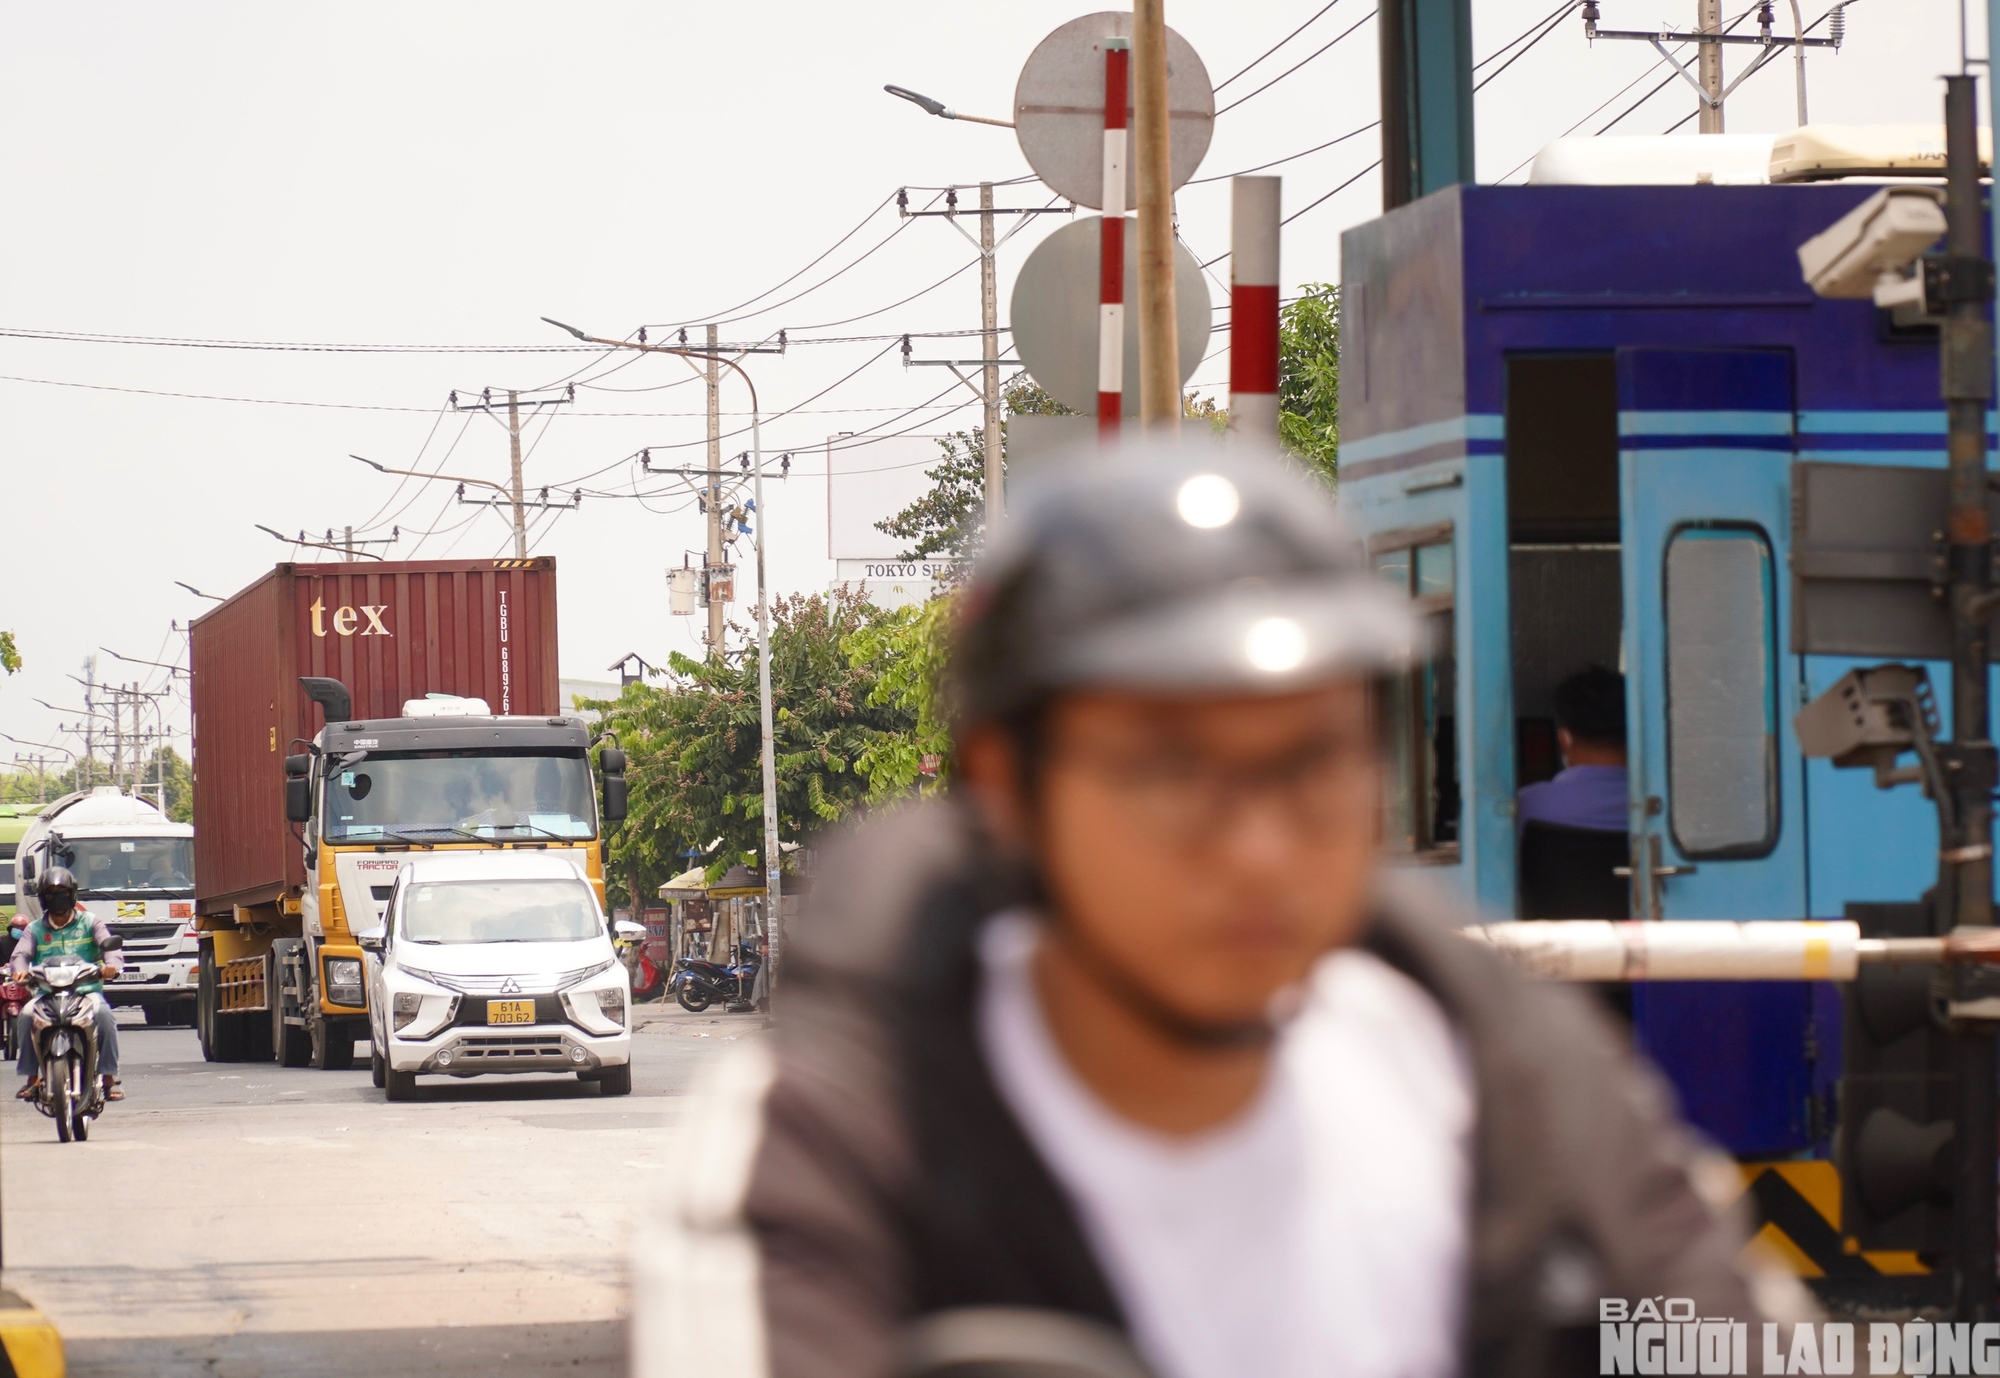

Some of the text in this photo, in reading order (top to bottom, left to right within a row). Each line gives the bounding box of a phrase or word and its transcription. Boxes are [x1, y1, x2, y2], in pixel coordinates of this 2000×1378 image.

[865, 564, 952, 577] TOKYO SHA
[499, 591, 509, 715] TGBU 68926
[500, 1002, 521, 1012] 61A
[493, 1013, 530, 1023] 703.62
